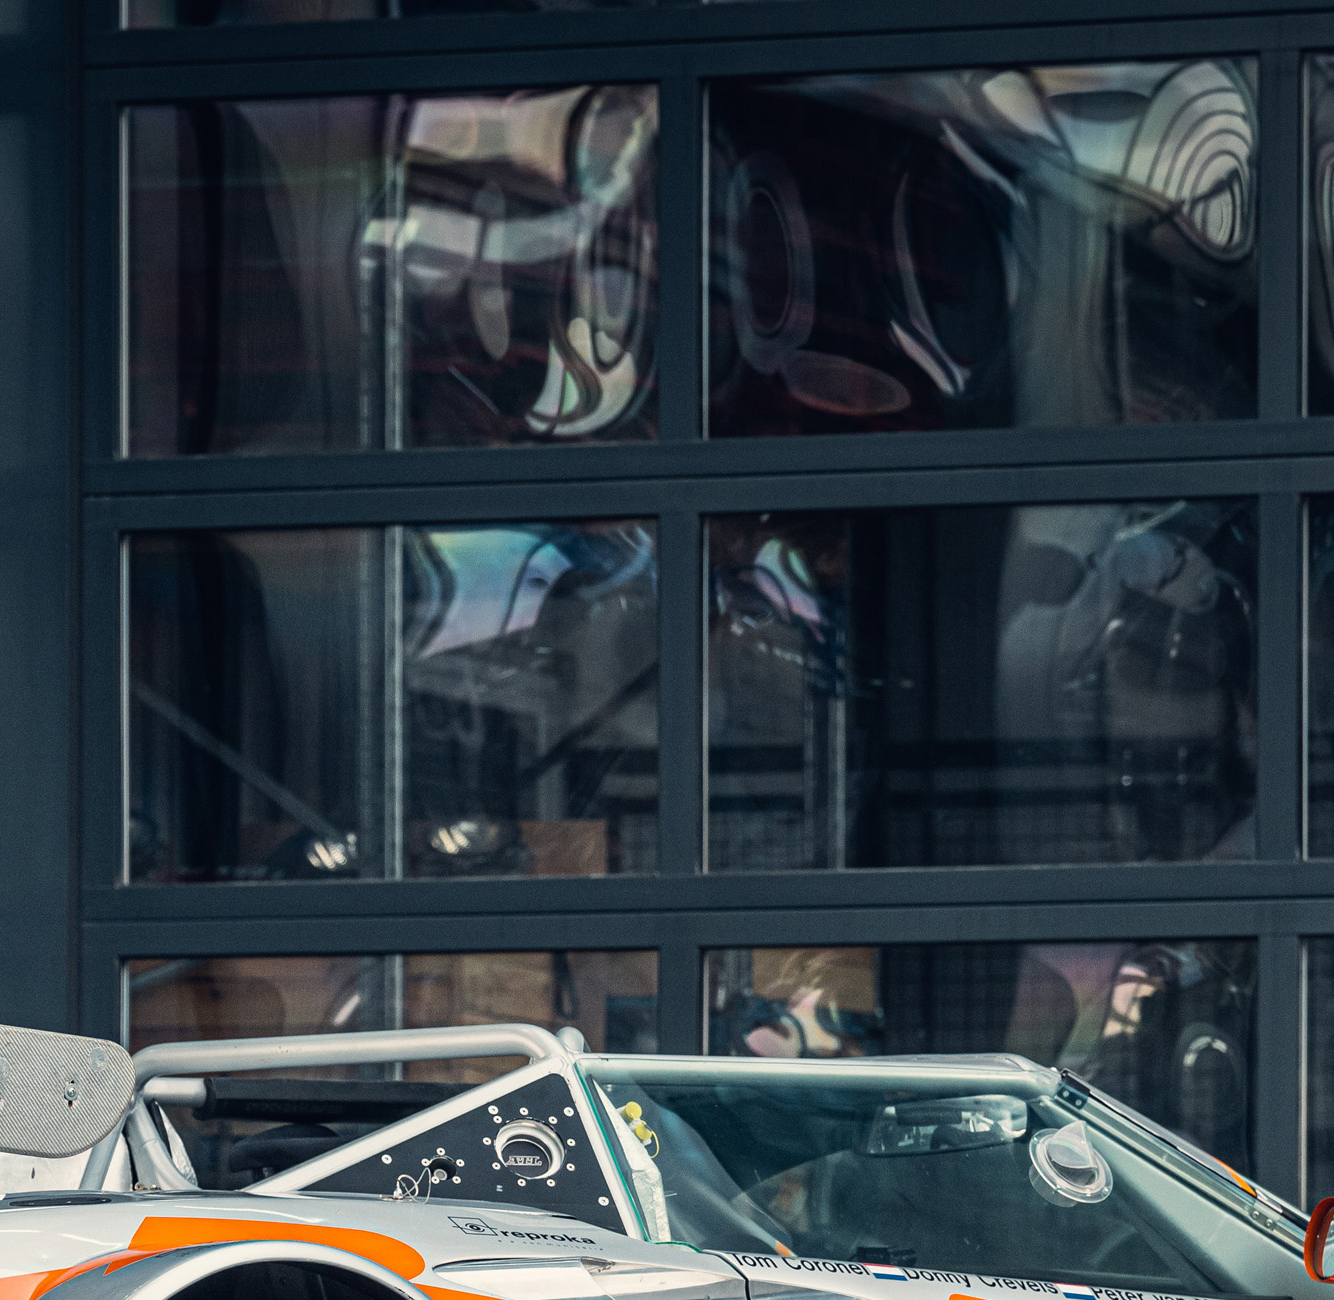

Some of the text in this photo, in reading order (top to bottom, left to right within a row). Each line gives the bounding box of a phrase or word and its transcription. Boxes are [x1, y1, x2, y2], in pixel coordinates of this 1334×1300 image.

[500, 1230, 596, 1246] reproka
[731, 1252, 778, 1269] Tom
[781, 1256, 871, 1276] Coronel
[902, 1268, 971, 1288] Donny
